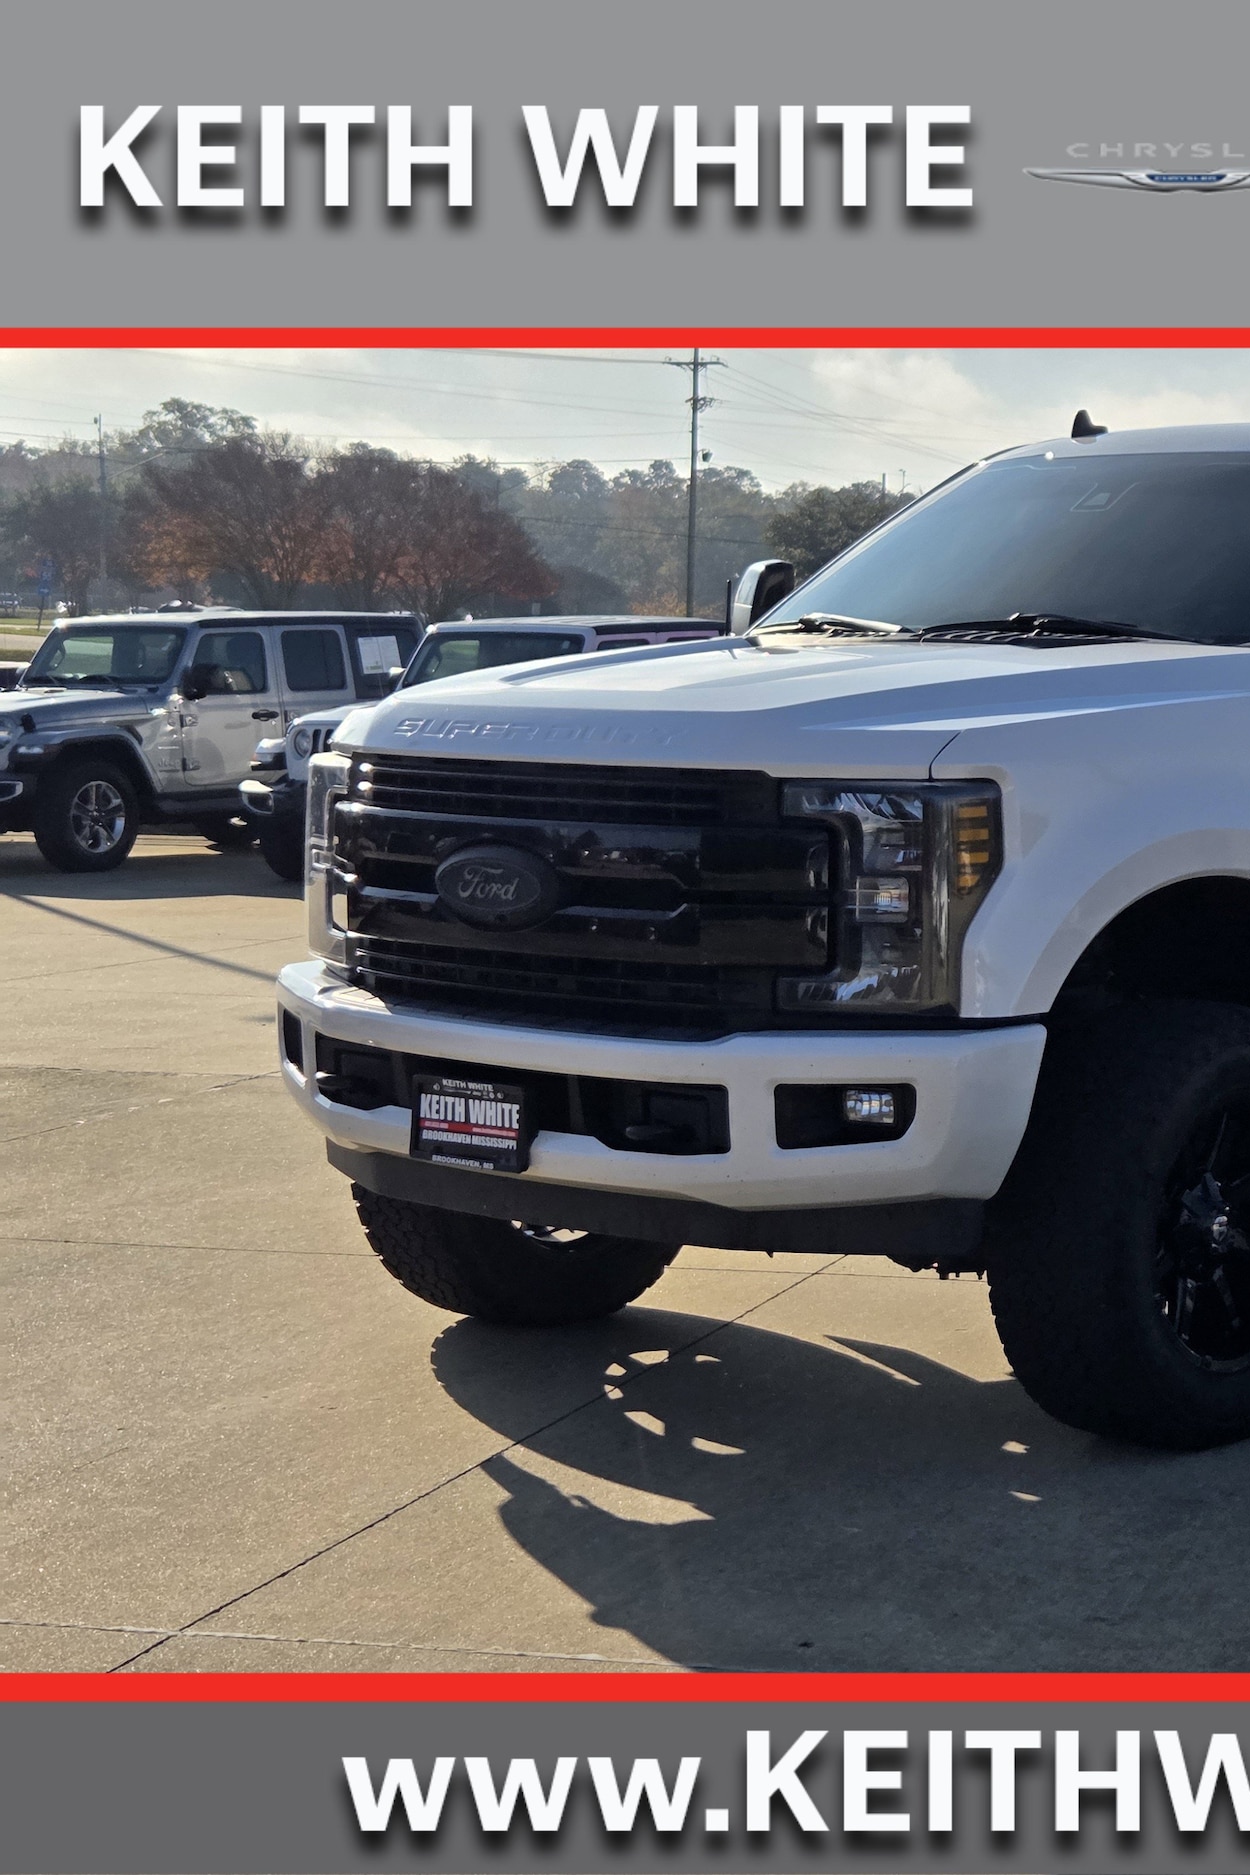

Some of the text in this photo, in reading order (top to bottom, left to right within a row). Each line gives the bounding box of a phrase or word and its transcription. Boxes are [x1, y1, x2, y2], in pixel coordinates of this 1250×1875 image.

[393, 717, 540, 742] SUPER
[458, 865, 520, 902] Ford
[442, 1078, 494, 1092] KEITH WHITE
[420, 1093, 466, 1122] KEITH
[468, 1099, 520, 1129] WHITE
[422, 1129, 472, 1145] BROOKHAVEN
[471, 1135, 517, 1150] MISSISSIPPI
